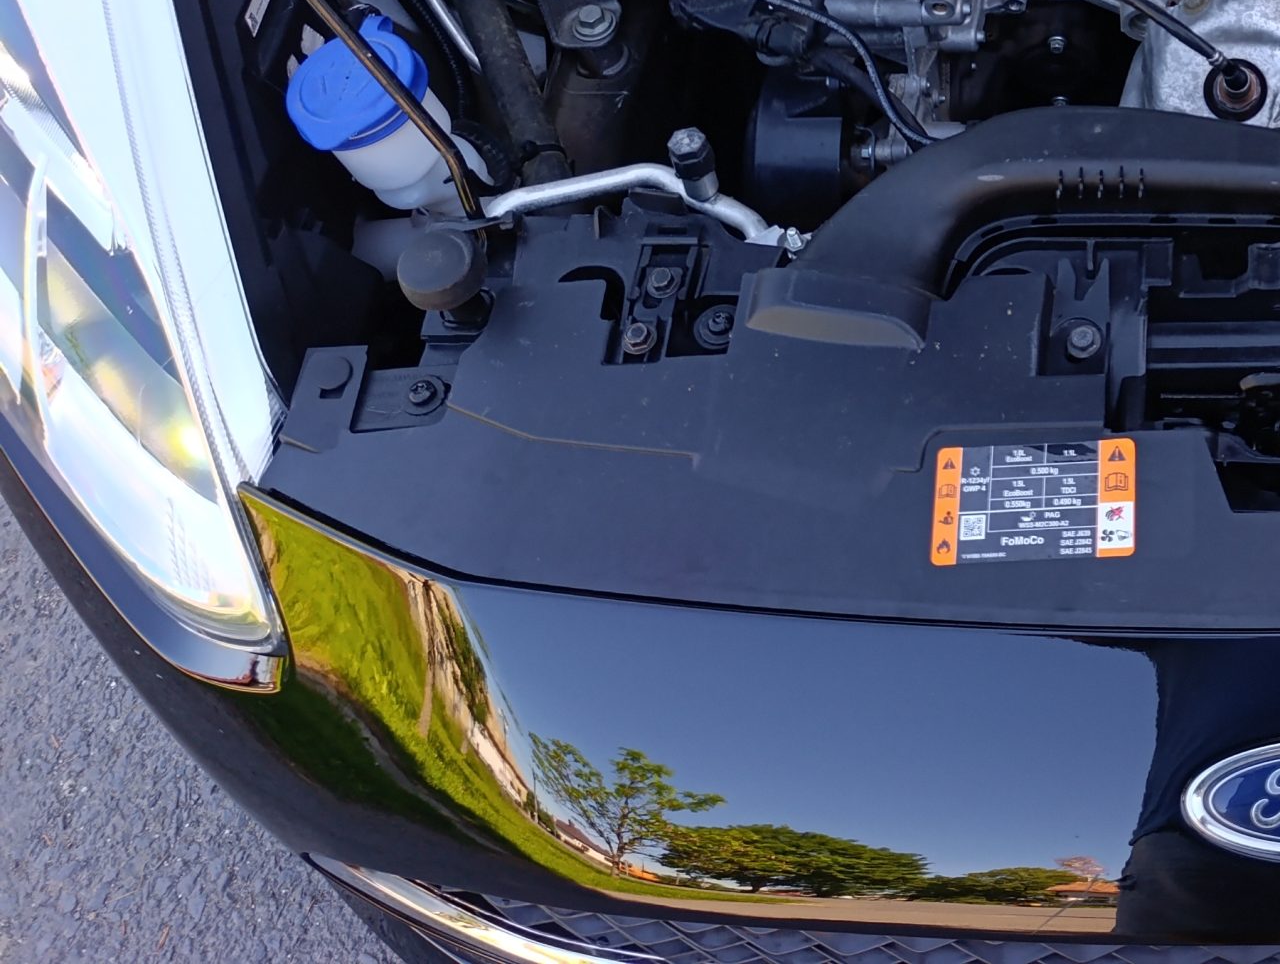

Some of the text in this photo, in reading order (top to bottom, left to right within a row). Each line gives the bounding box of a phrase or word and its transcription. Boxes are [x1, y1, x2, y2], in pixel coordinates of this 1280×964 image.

[1050, 467, 1059, 476] kg
[1003, 489, 1033, 497] EcoBoost
[1072, 498, 1081, 506] kg
[1044, 511, 1061, 519] PAG
[1062, 530, 1075, 538] SAE
[1000, 535, 1045, 547] FoMoCo
[1060, 539, 1074, 547] SAE
